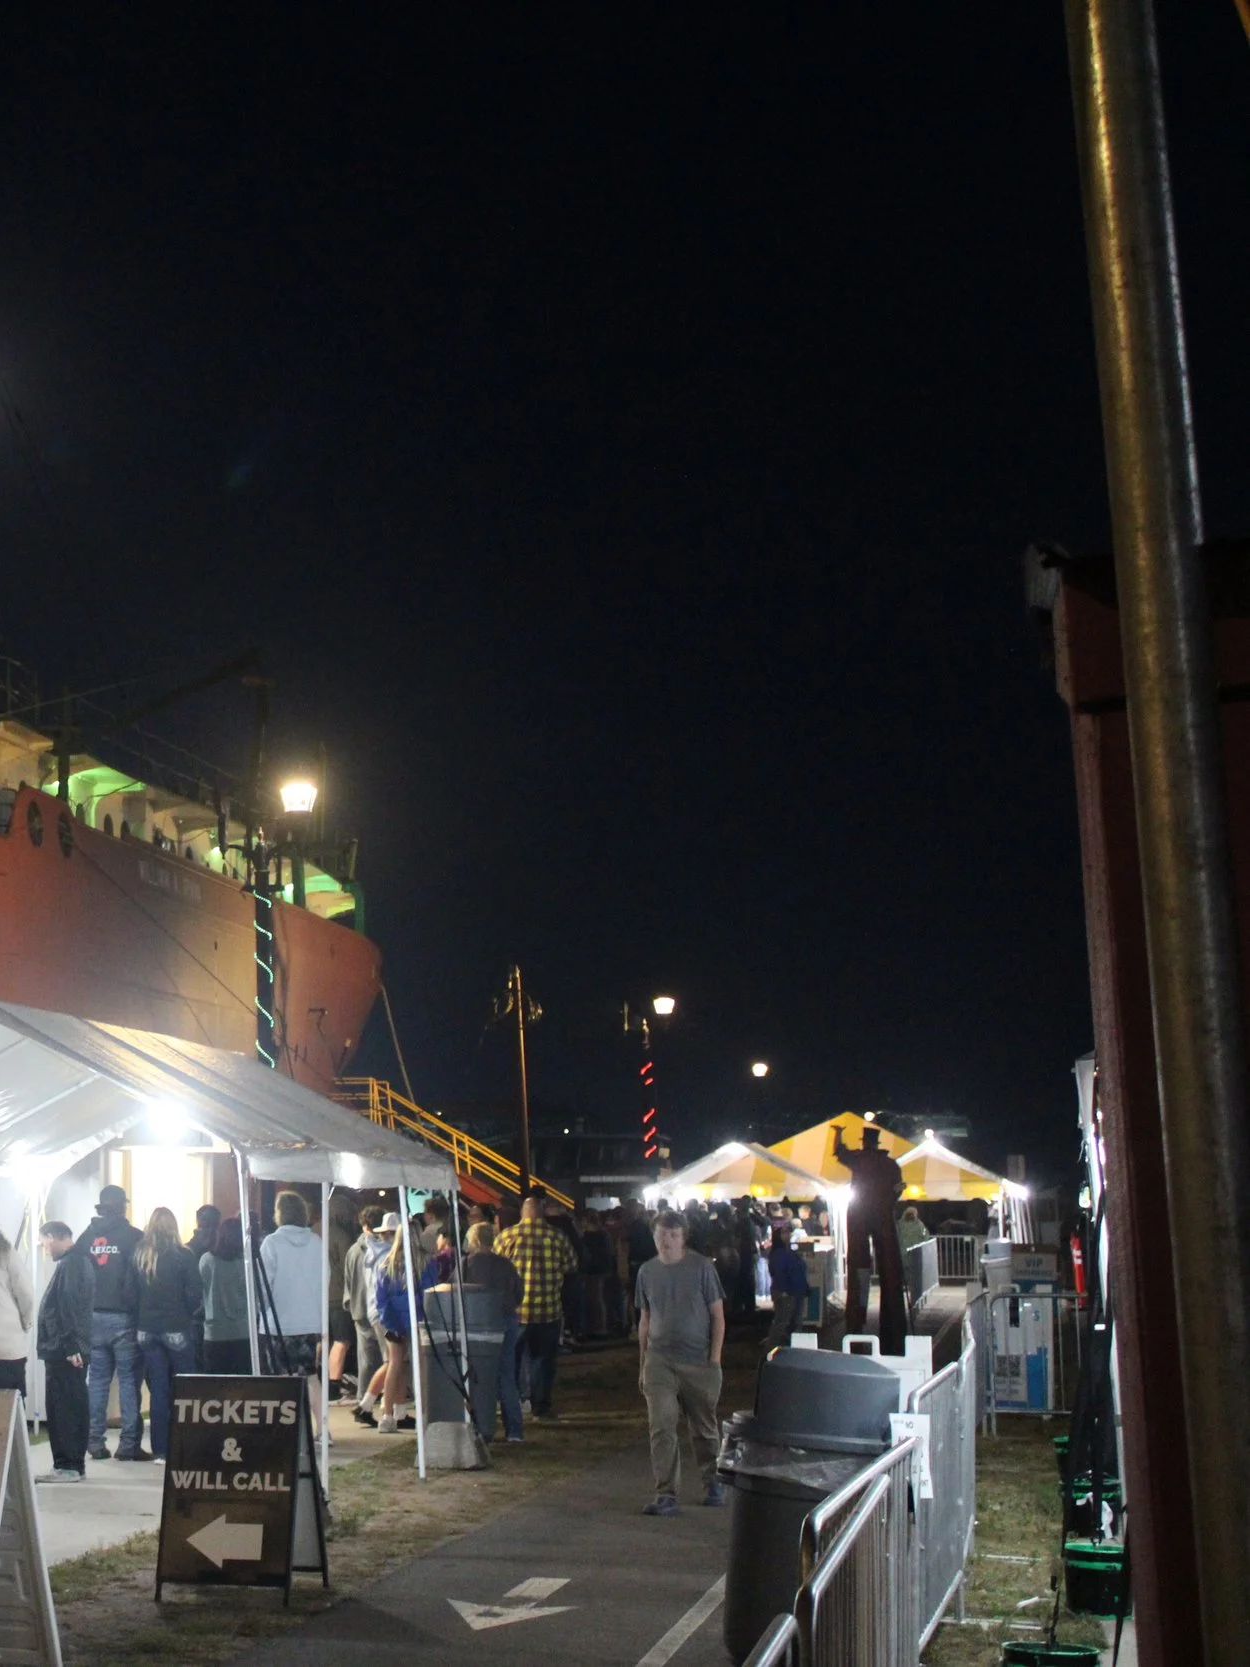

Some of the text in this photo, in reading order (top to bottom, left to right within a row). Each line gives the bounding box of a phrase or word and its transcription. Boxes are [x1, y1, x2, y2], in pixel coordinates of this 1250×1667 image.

[174, 1398, 297, 1425] TICKETS
[221, 1437, 243, 1462] &
[171, 1470, 291, 1492] WILL CALL
